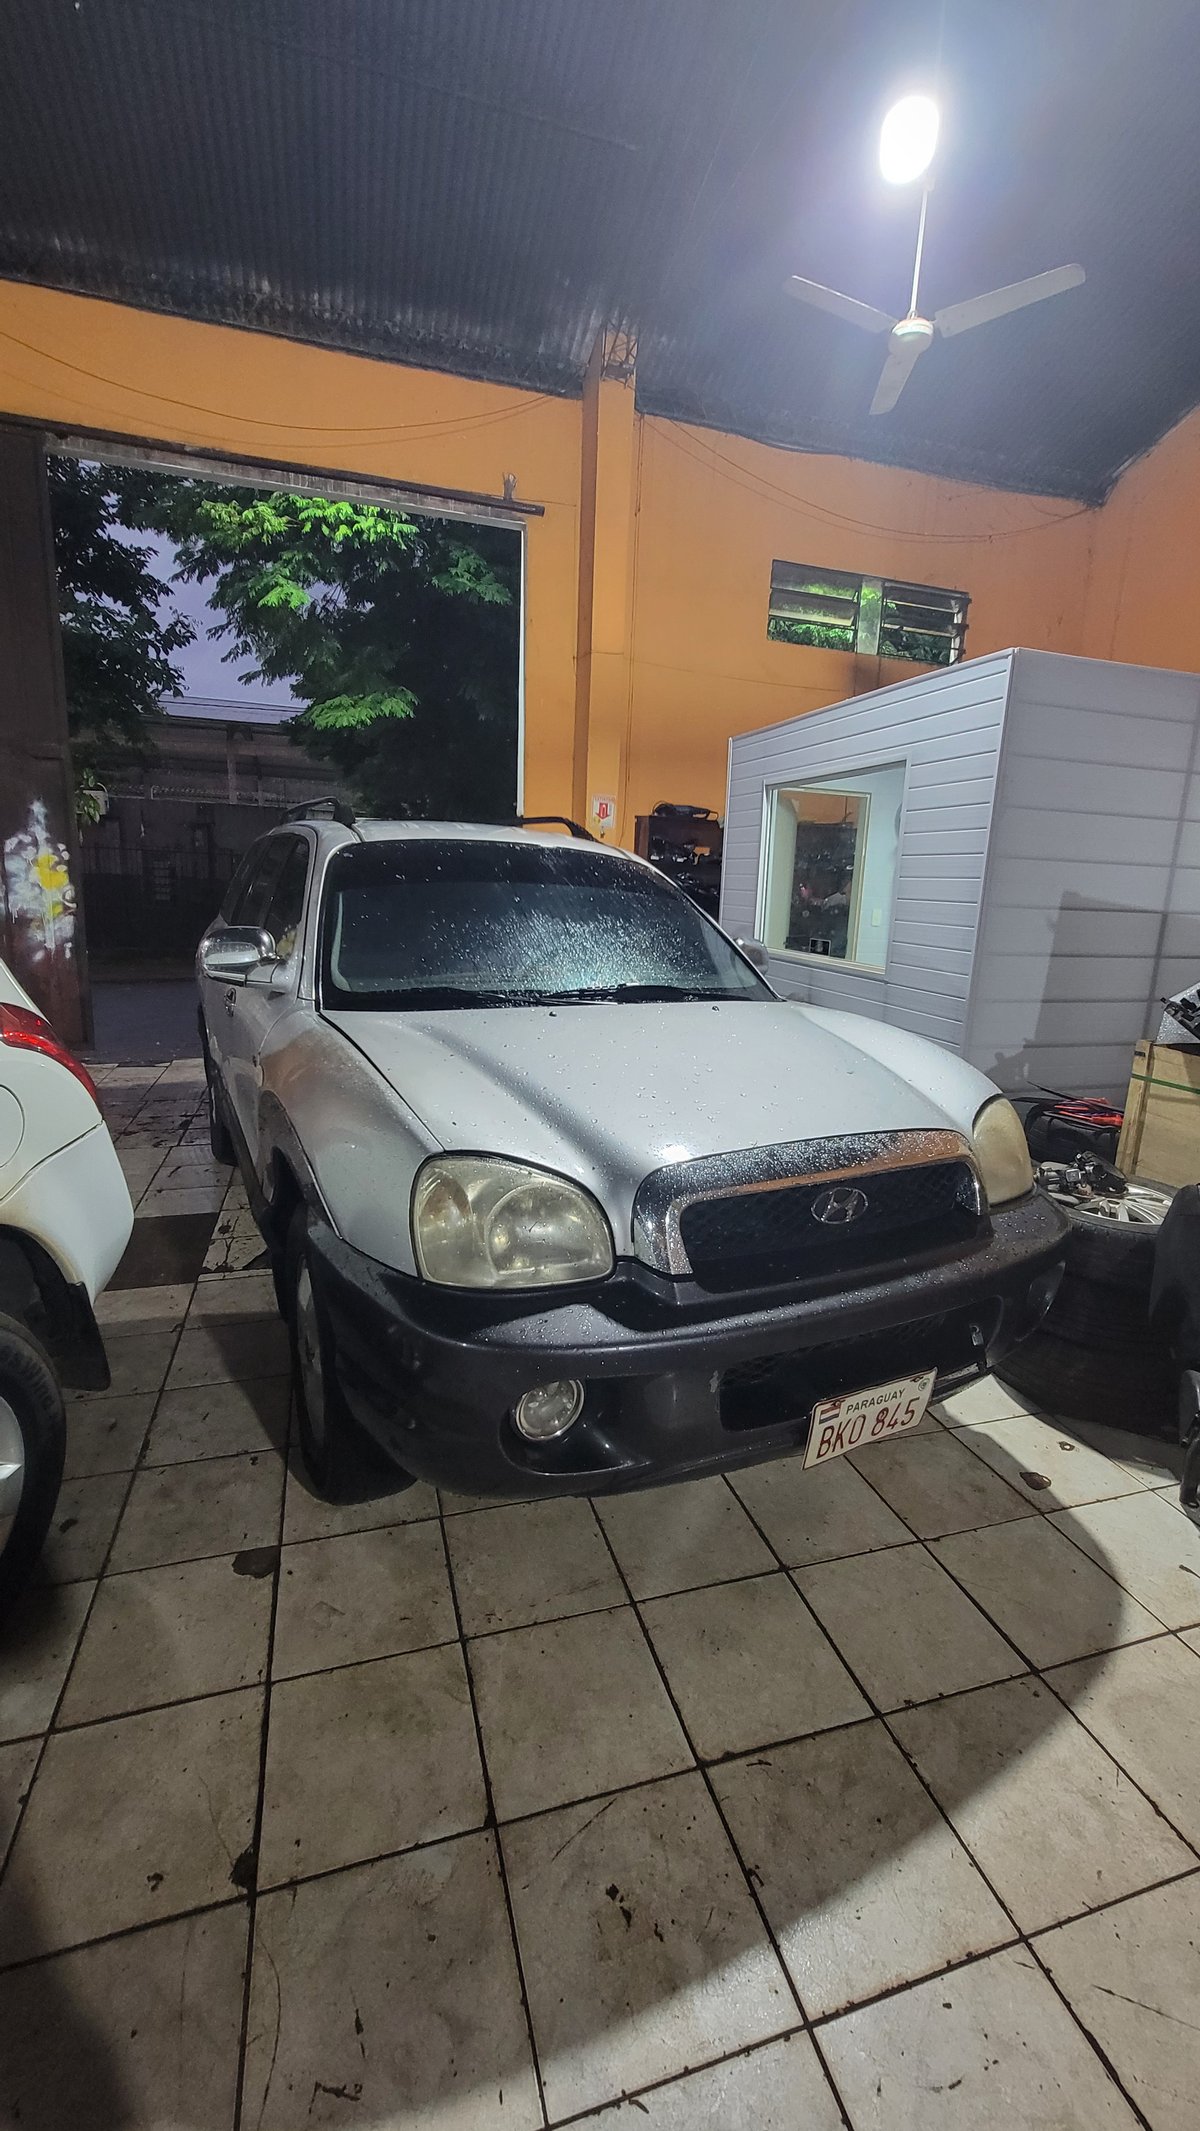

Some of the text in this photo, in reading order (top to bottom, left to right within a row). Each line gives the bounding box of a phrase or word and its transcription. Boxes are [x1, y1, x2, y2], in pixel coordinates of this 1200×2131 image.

[846, 1388, 905, 1415] PARAGUAY
[816, 1396, 920, 1459] BKO 845
